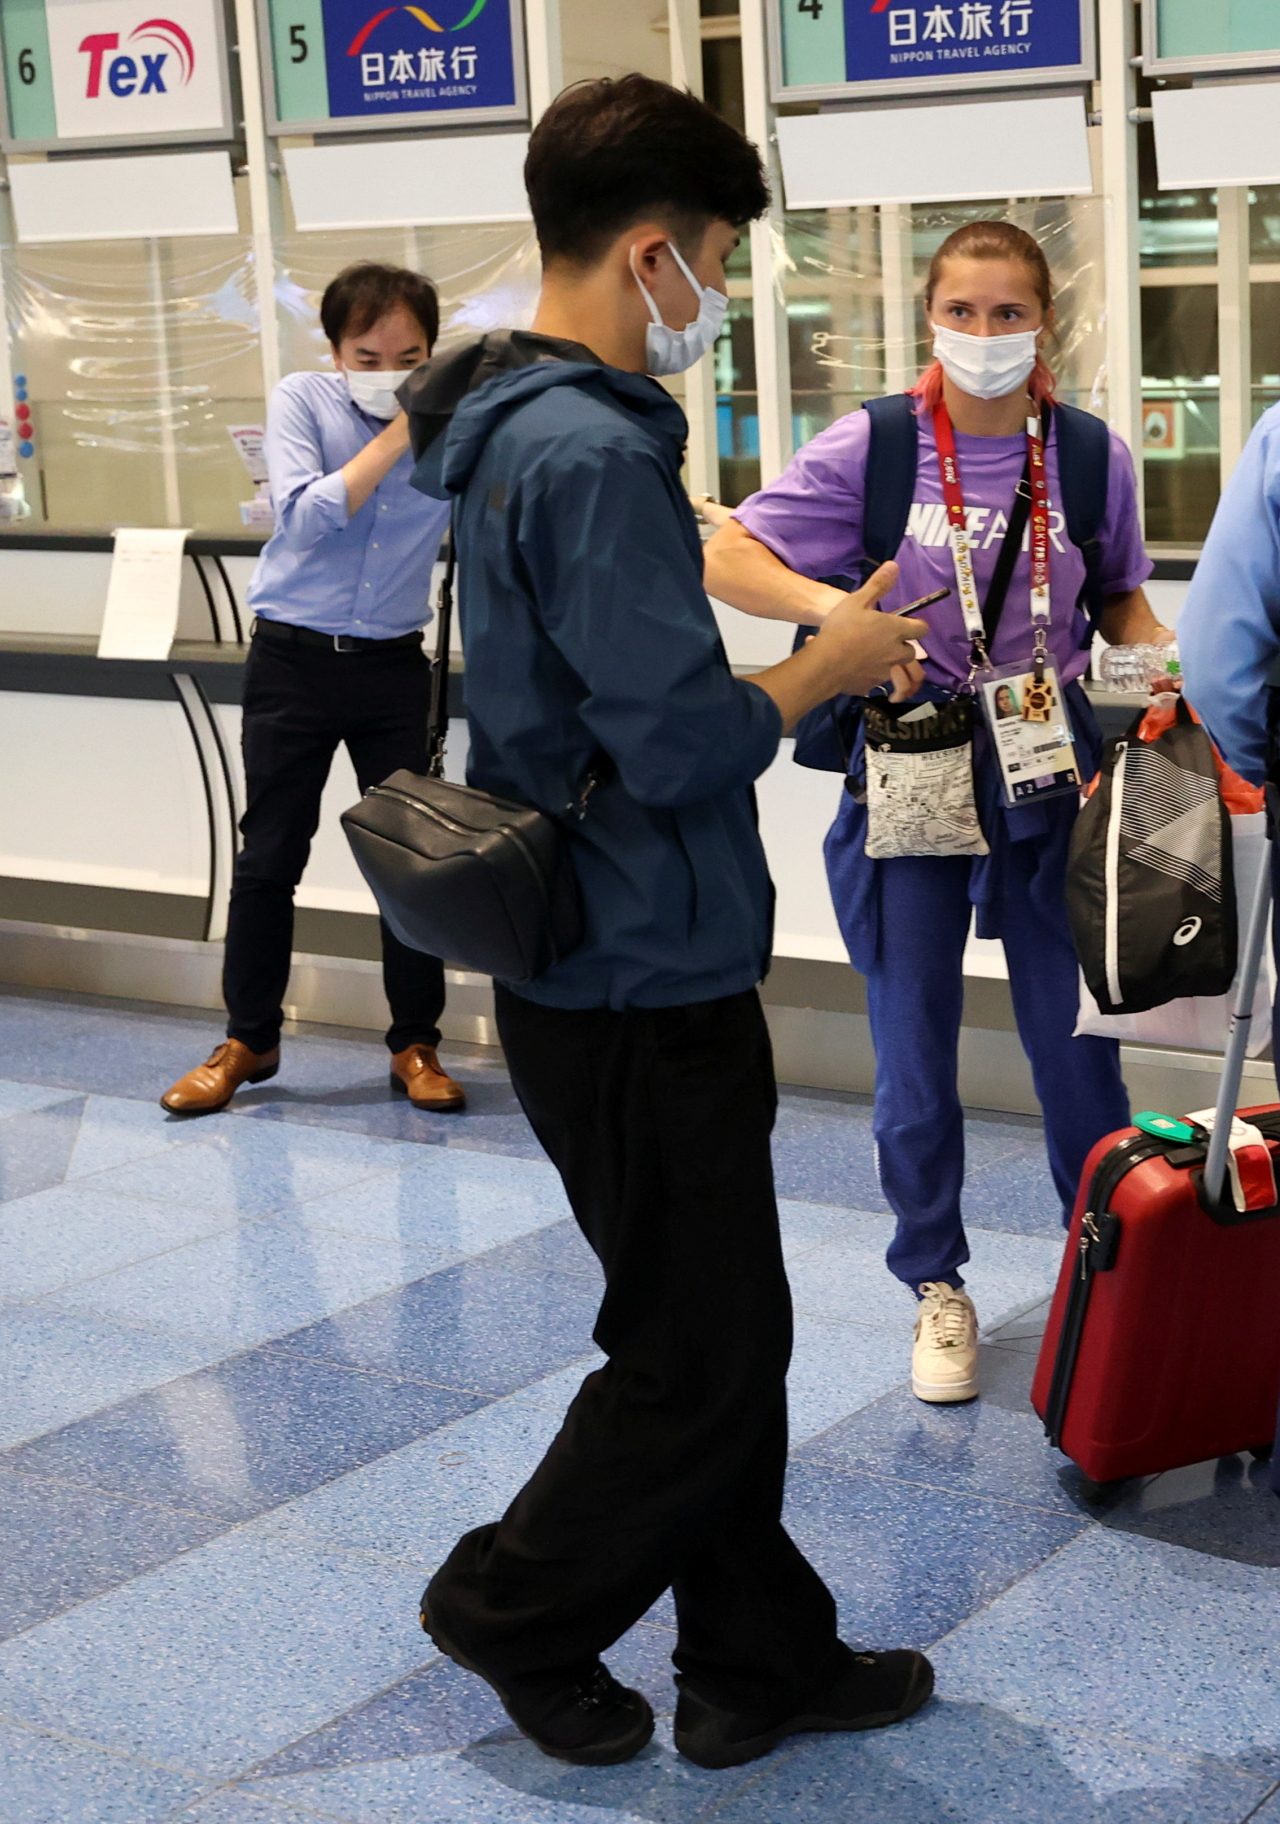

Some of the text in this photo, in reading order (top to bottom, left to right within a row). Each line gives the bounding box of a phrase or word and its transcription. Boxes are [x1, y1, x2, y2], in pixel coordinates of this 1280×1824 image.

[888, 0, 1034, 46] 日本旅行
[289, 24, 308, 64] 5
[889, 42, 1032, 64] NIPPON TRAVEL AGENCY
[18, 48, 36, 85] 6
[78, 33, 168, 98] Tex
[361, 45, 478, 86] 日本旅行
[364, 85, 477, 102] NIPPON TRAVEL AGENCY
